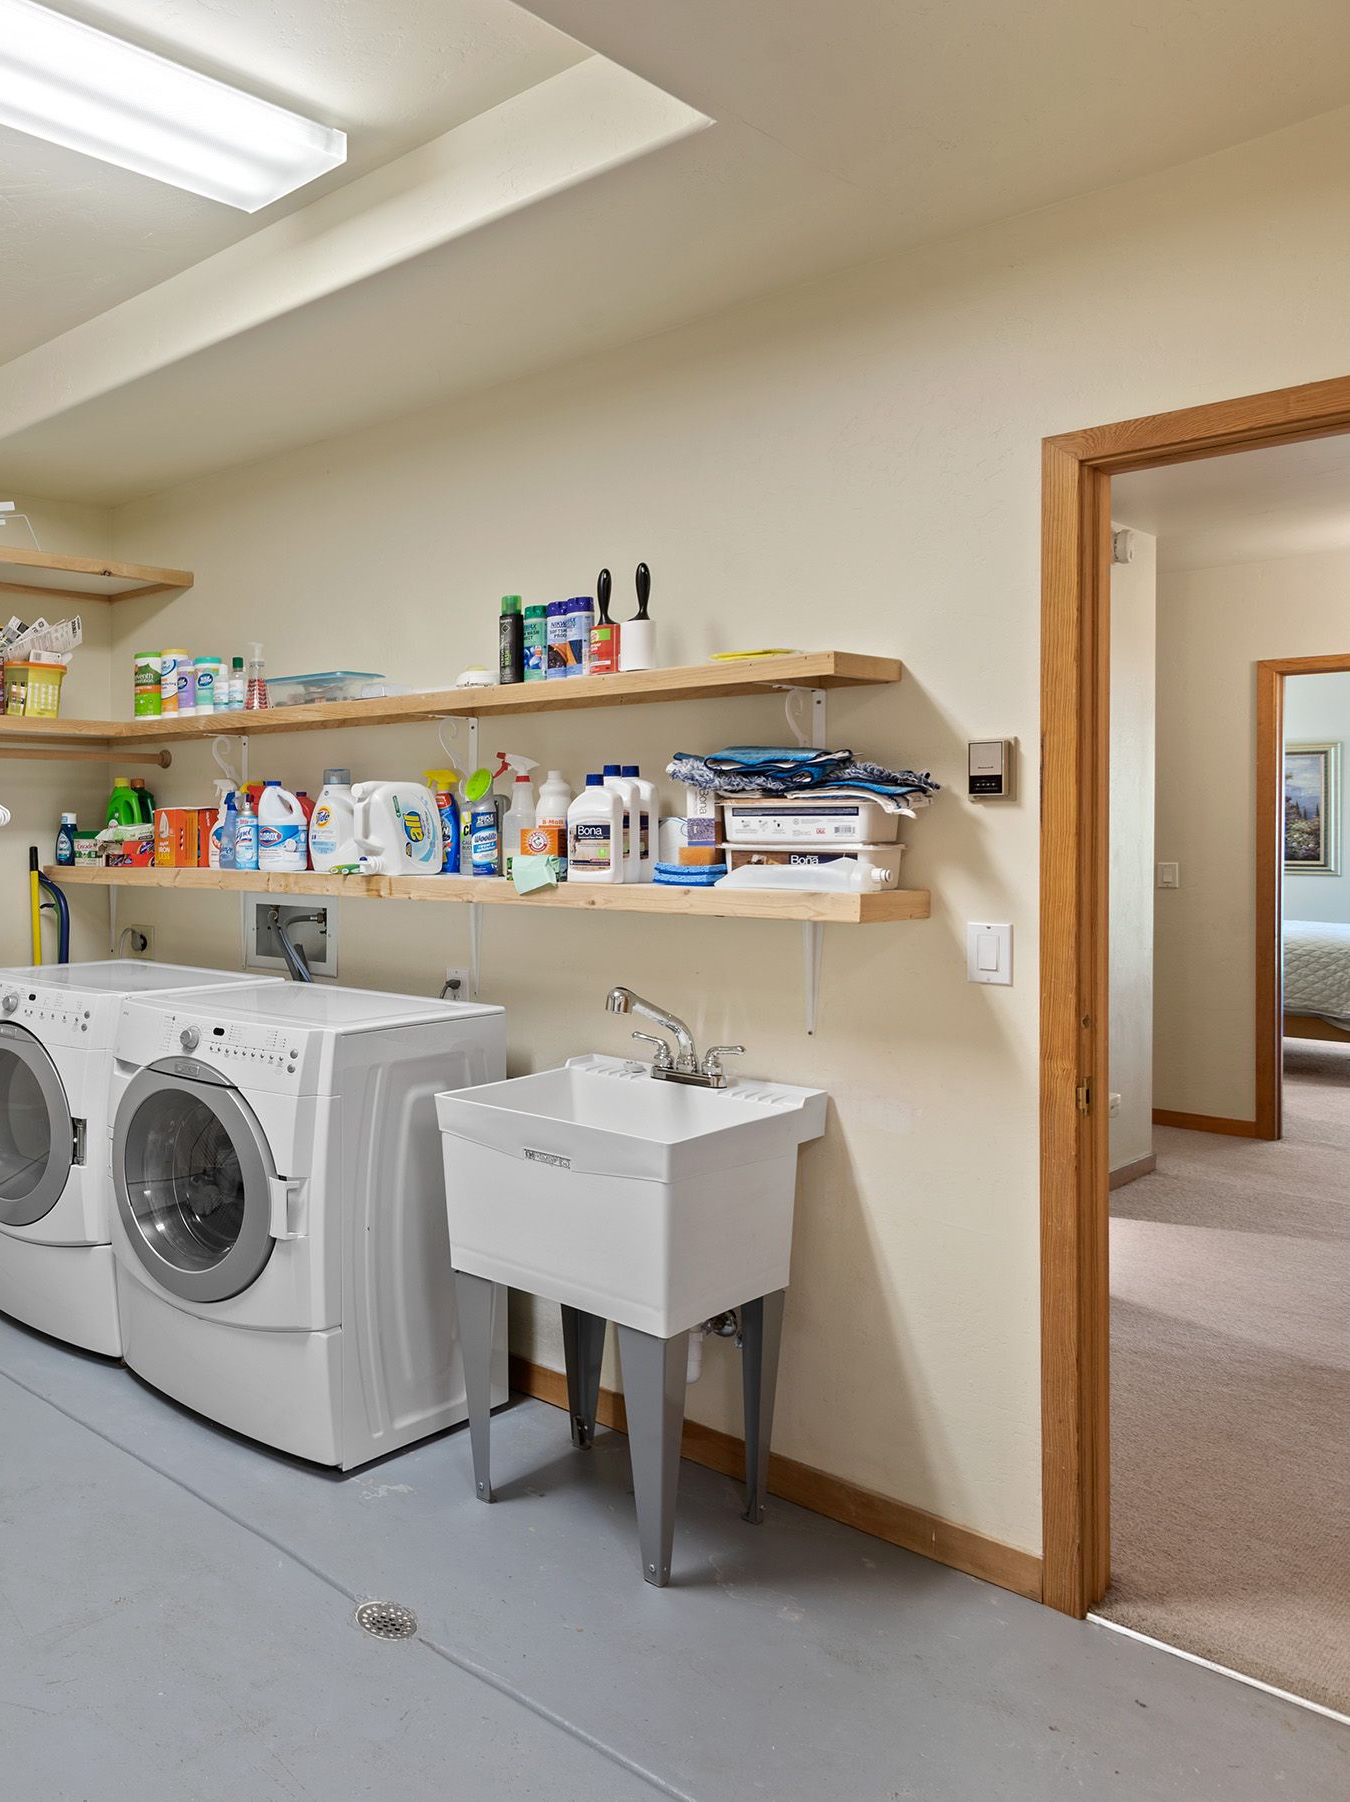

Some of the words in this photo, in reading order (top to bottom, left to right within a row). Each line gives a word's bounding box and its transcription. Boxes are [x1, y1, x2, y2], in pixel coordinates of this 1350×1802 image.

[316, 810, 330, 824] Tide
[403, 815, 424, 841] all
[577, 825, 603, 836] Bona
[790, 854, 819, 866] Bona
